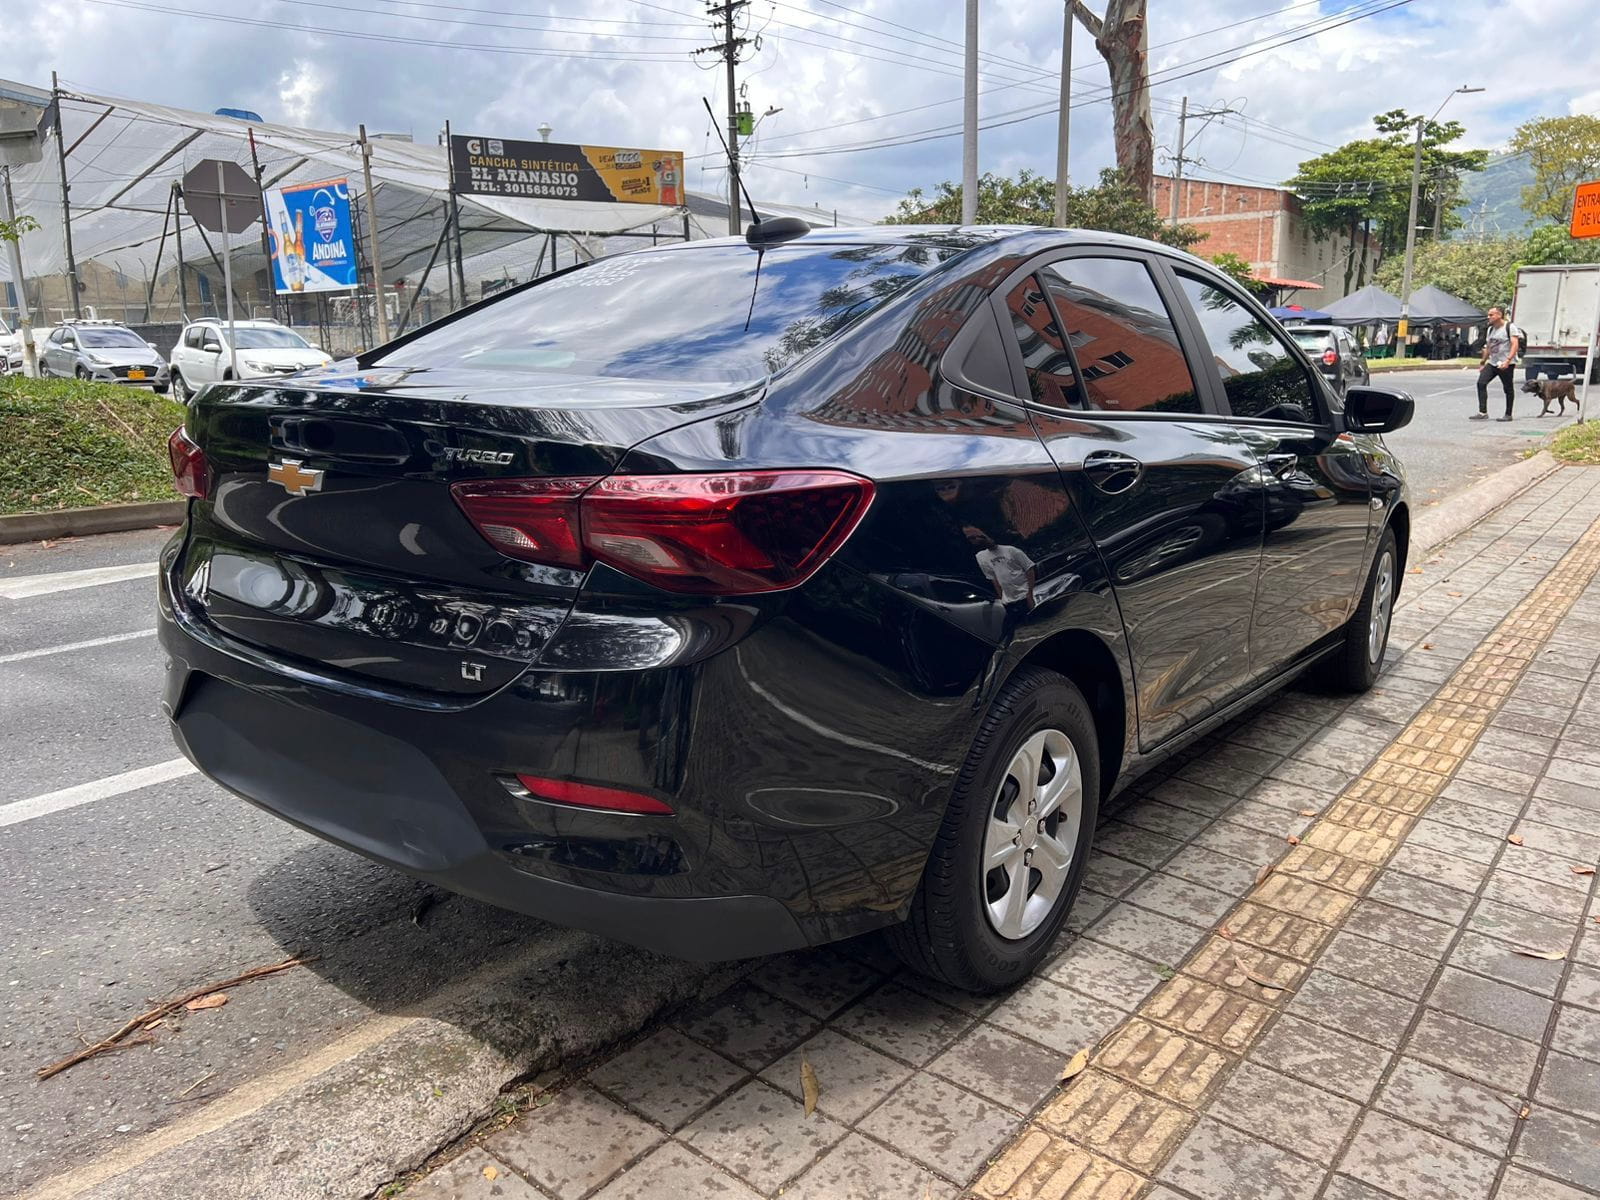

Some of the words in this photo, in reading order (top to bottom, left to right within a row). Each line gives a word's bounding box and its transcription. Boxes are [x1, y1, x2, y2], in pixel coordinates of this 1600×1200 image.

[469, 155, 517, 169] CANCHA
[521, 159, 579, 172] SINTÉTICA
[470, 167, 492, 180] EL
[497, 169, 579, 186] ATANASIO
[471, 181, 501, 192] TEL:
[504, 183, 578, 197] 3015684073
[1581, 212, 1591, 226] DE
[312, 239, 347, 261] ANDINA
[443, 446, 514, 465] TURBO
[461, 661, 487, 681] LT
